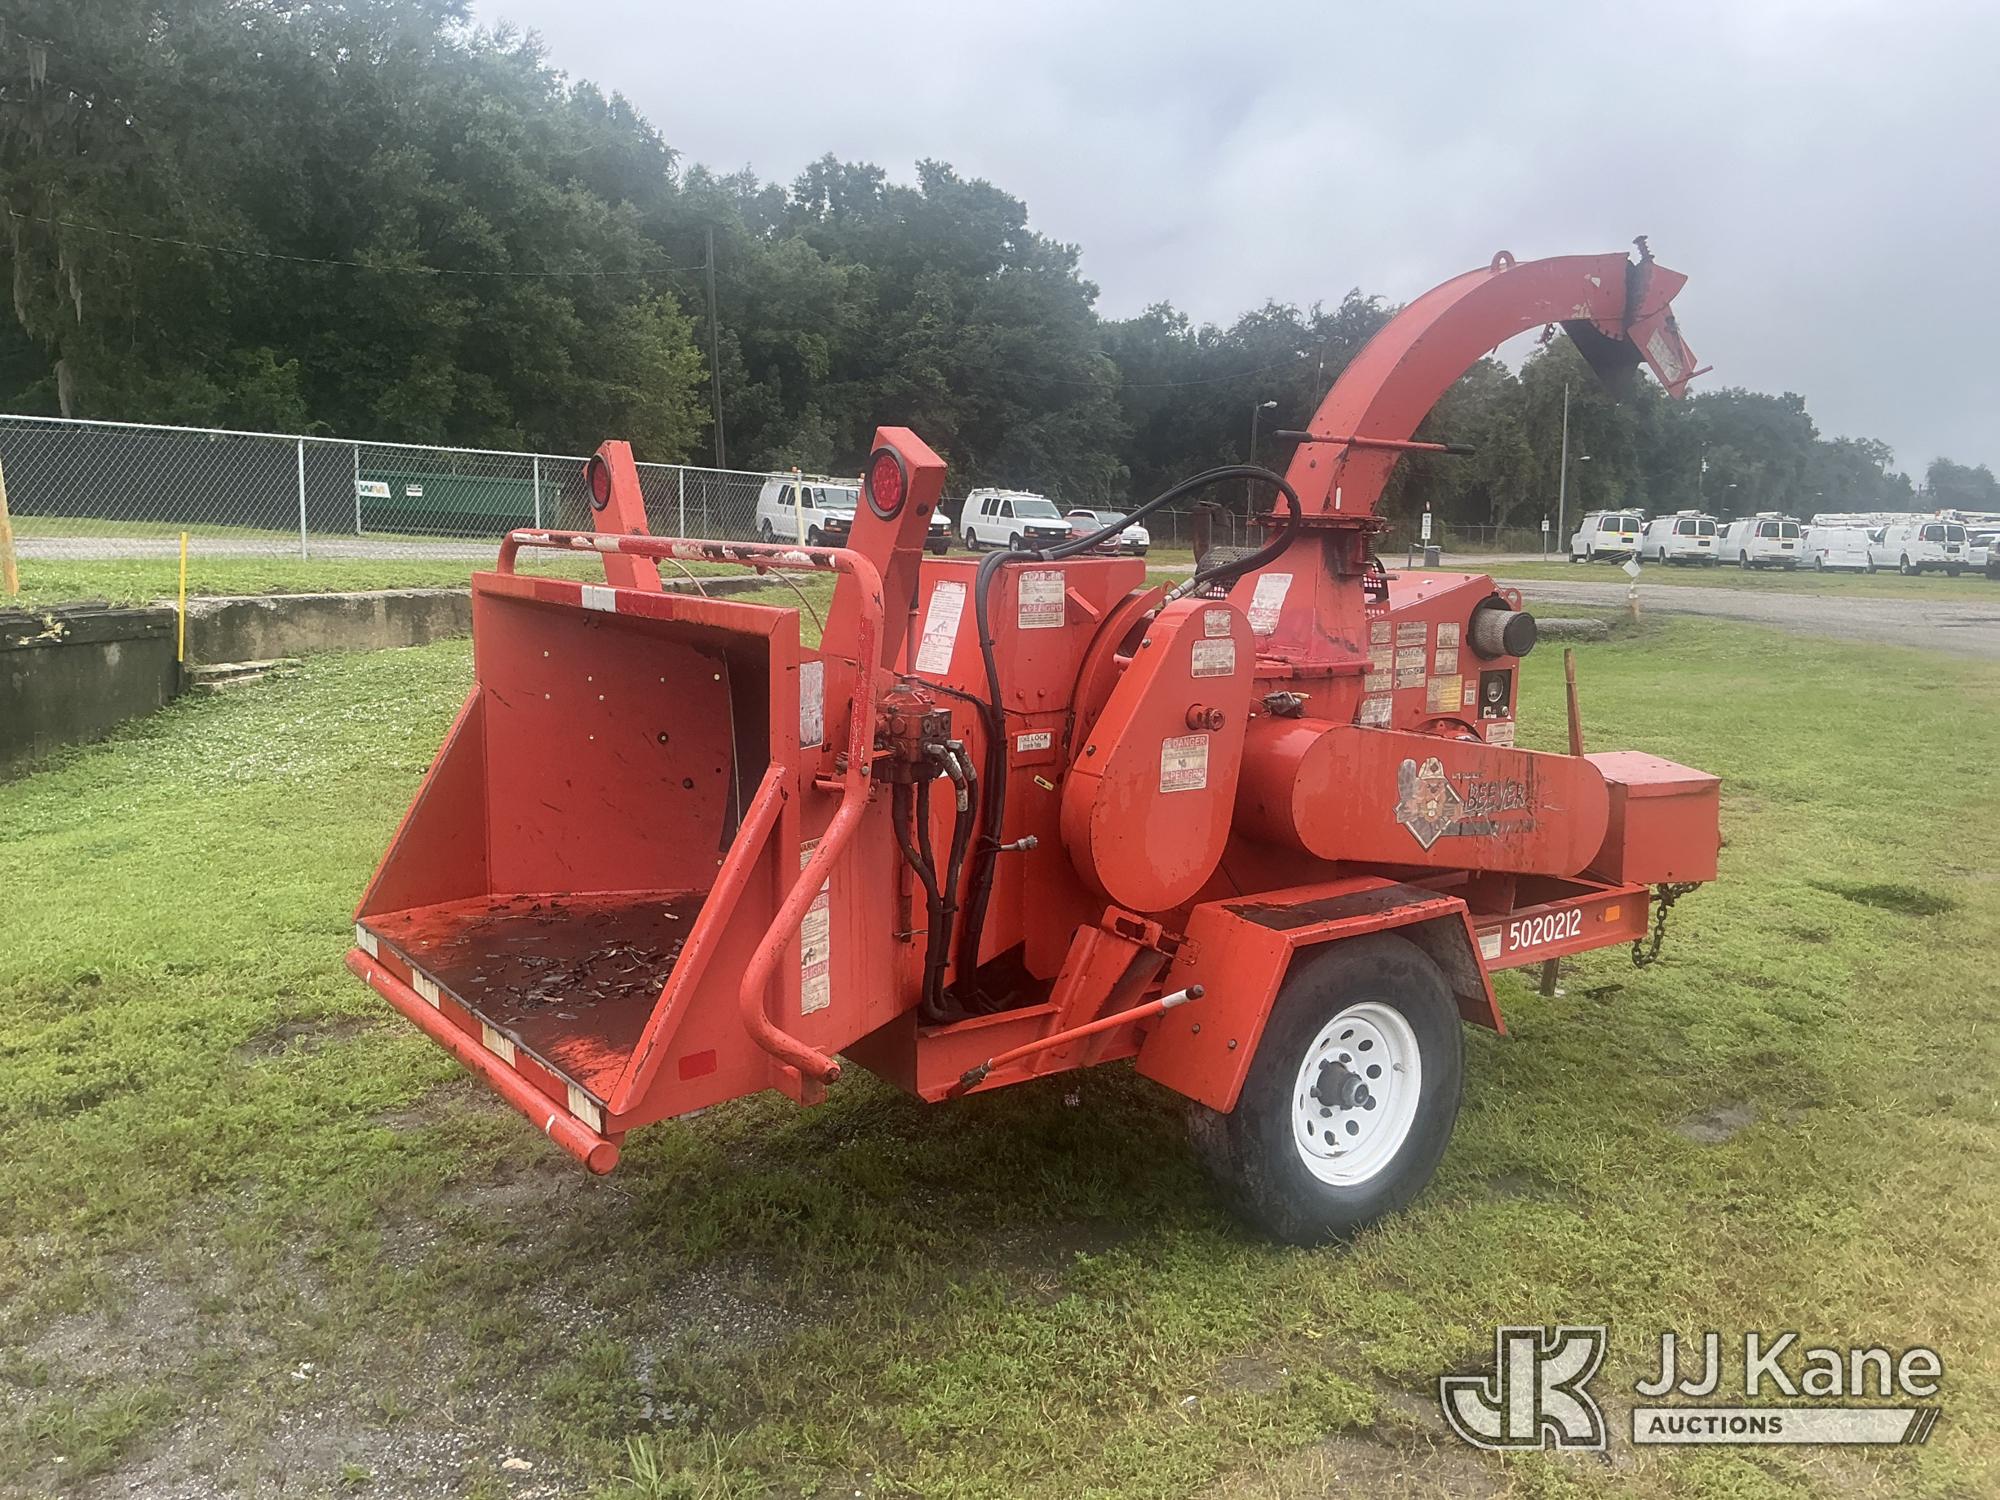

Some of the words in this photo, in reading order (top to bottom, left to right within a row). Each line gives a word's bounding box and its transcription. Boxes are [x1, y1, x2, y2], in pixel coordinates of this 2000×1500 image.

[360, 484, 385, 494] WM
[1030, 733, 1048, 741] LOCK
[1172, 736, 1206, 749] DANGER
[1170, 768, 1205, 781] PELIGRO
[1509, 908, 1582, 951] 5020212
[801, 961, 828, 982] ELIGRO
